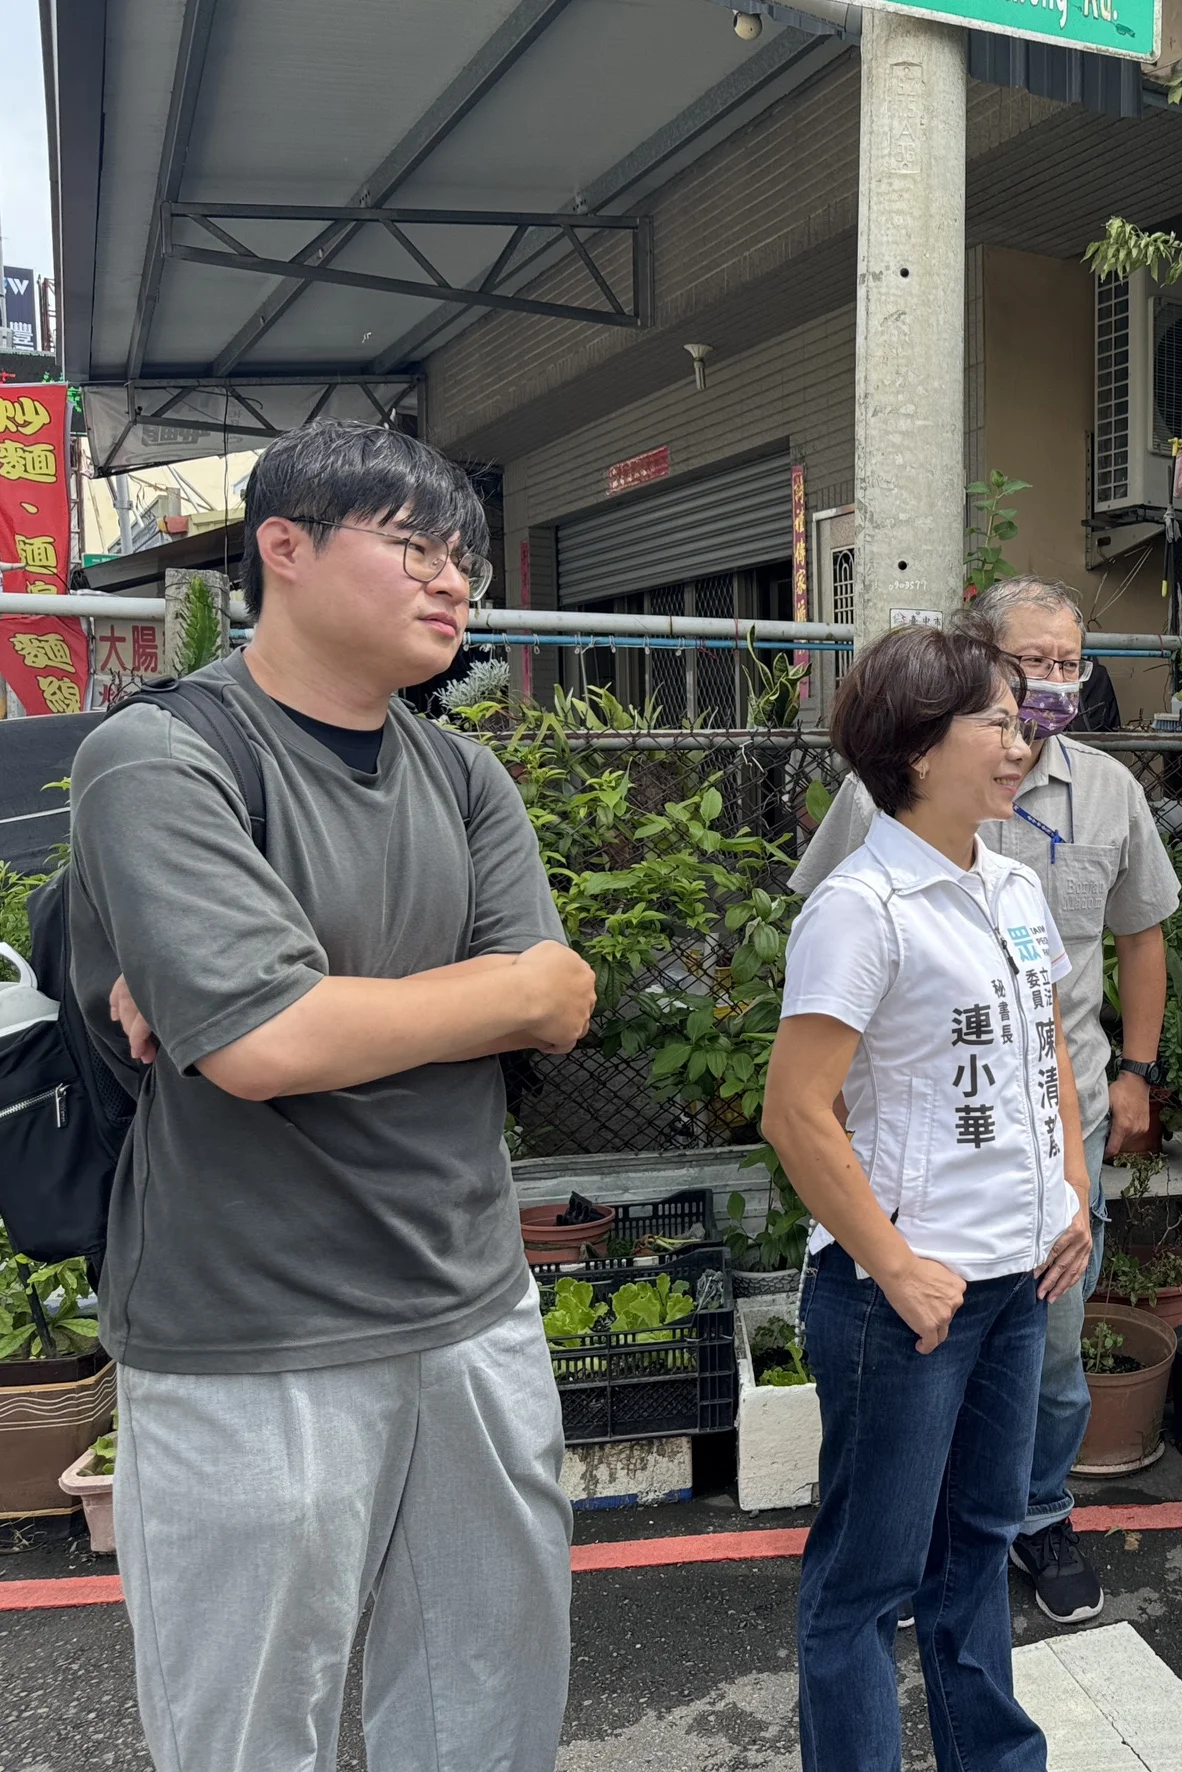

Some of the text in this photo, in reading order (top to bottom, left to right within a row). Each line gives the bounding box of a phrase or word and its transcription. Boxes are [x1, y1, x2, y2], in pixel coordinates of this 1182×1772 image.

[99, 624, 164, 674] 大腸
[991, 979, 1013, 1044] 秘書長
[1025, 968, 1045, 1010] 委員
[951, 1003, 996, 1149] 連小華
